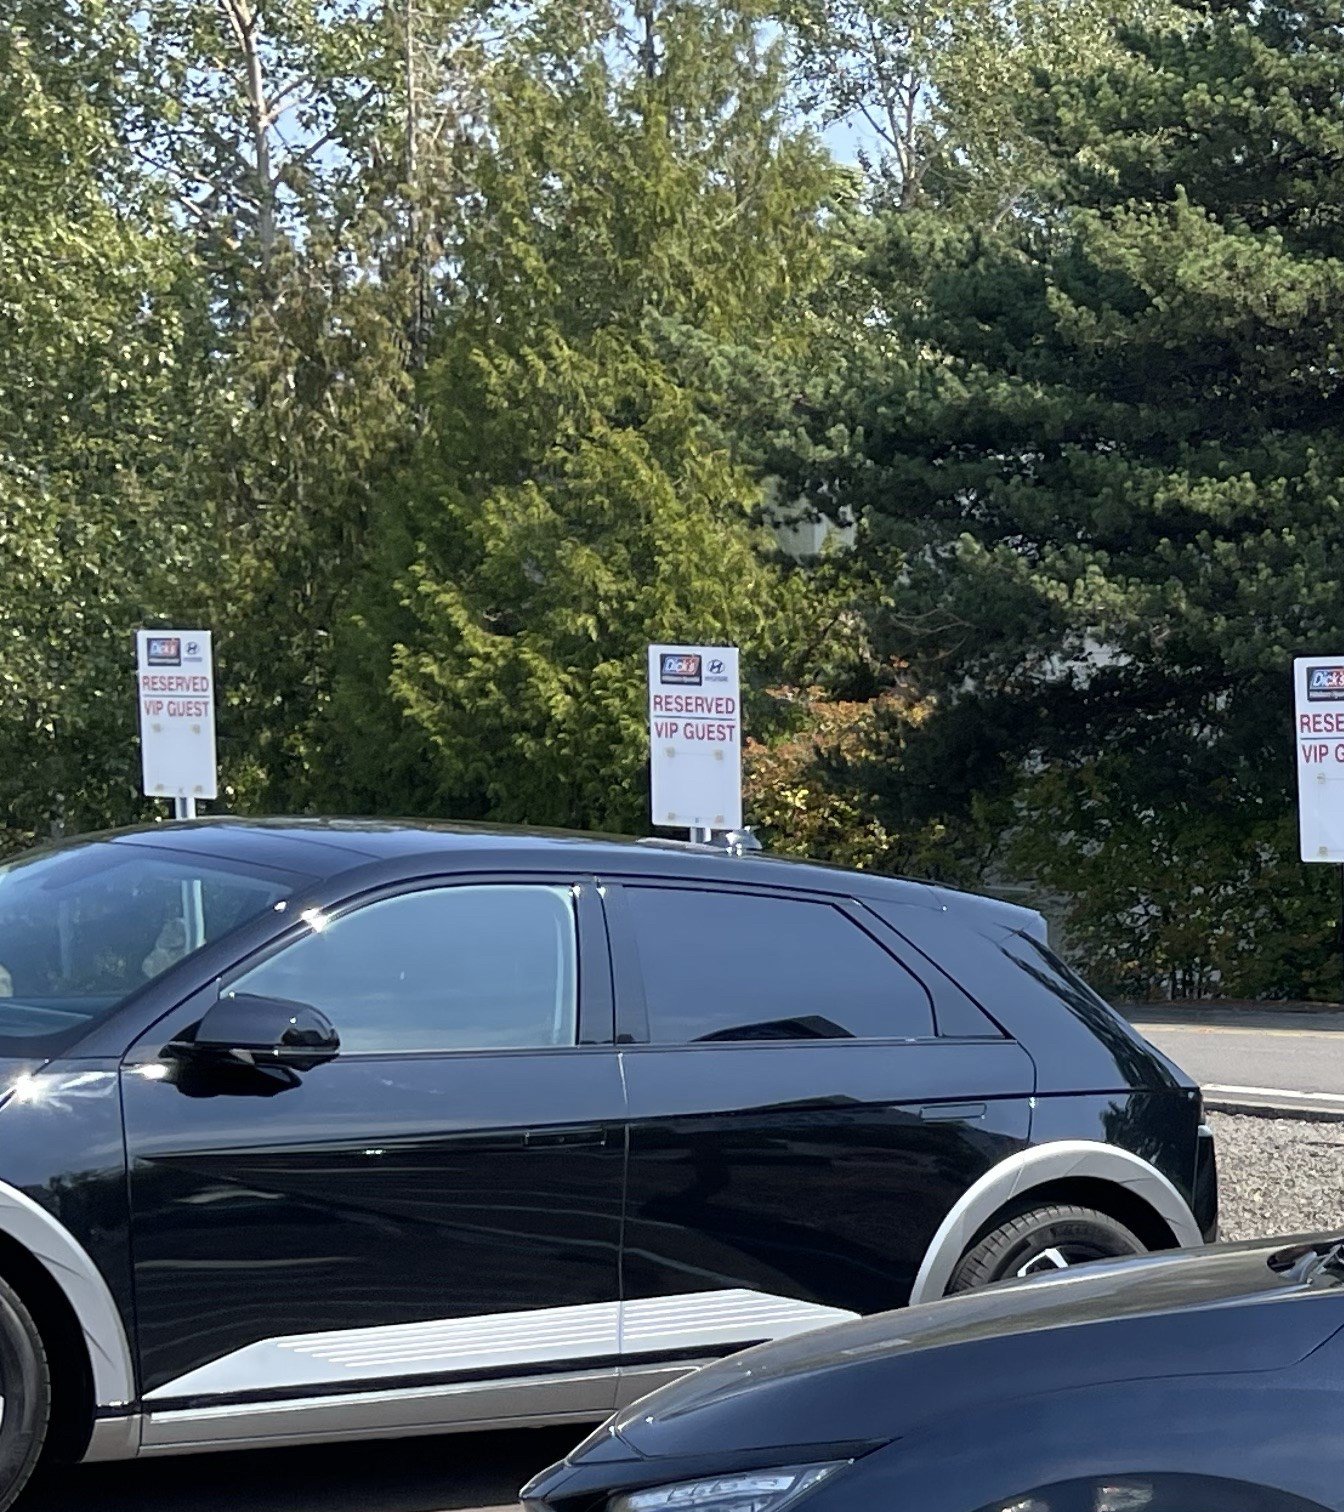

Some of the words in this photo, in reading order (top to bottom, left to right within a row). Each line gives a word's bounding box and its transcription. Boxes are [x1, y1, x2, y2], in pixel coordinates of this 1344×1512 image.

[143, 676, 209, 692] RESERVED
[144, 701, 163, 717] VIP
[167, 700, 209, 717] GUEST
[653, 695, 735, 715] RESERVED
[654, 722, 678, 739] VIP
[683, 723, 735, 742] GUEST
[1302, 744, 1329, 763] VIP
